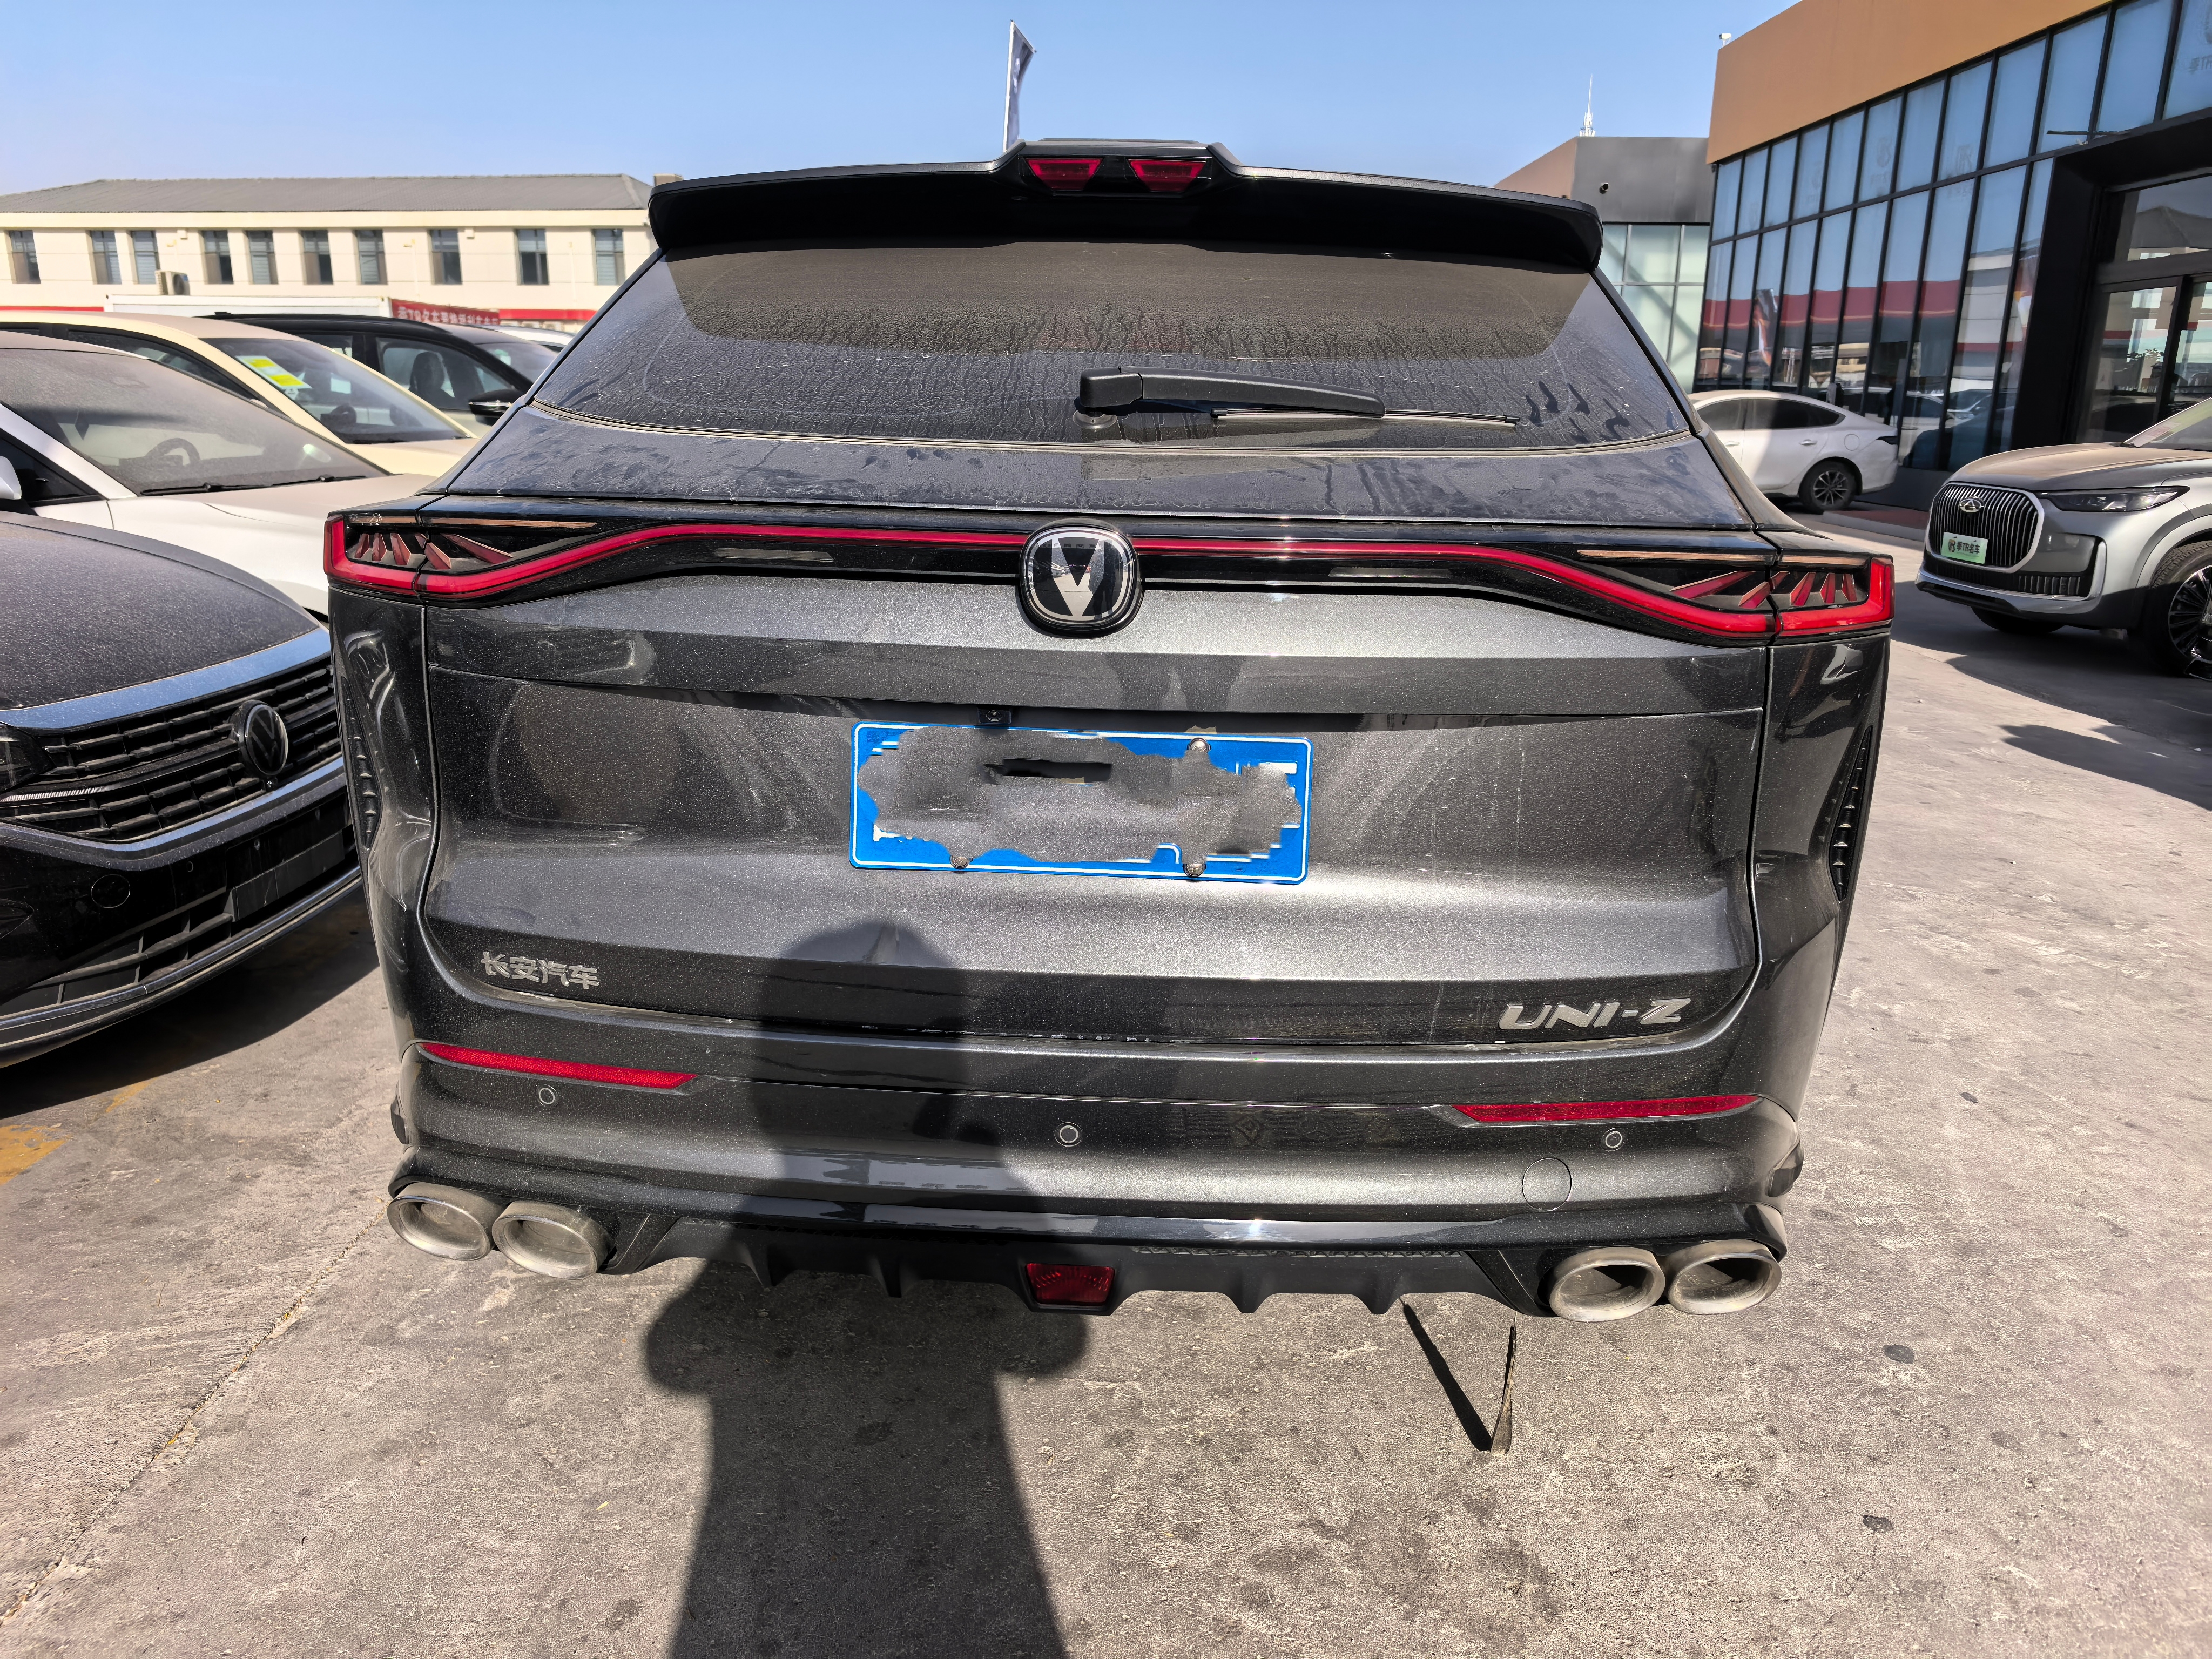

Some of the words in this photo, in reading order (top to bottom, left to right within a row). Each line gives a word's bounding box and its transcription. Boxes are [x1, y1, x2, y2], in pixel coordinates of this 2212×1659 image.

[481, 951, 599, 990] 长安汽车
[1498, 997, 1691, 1030] UNI-Z
